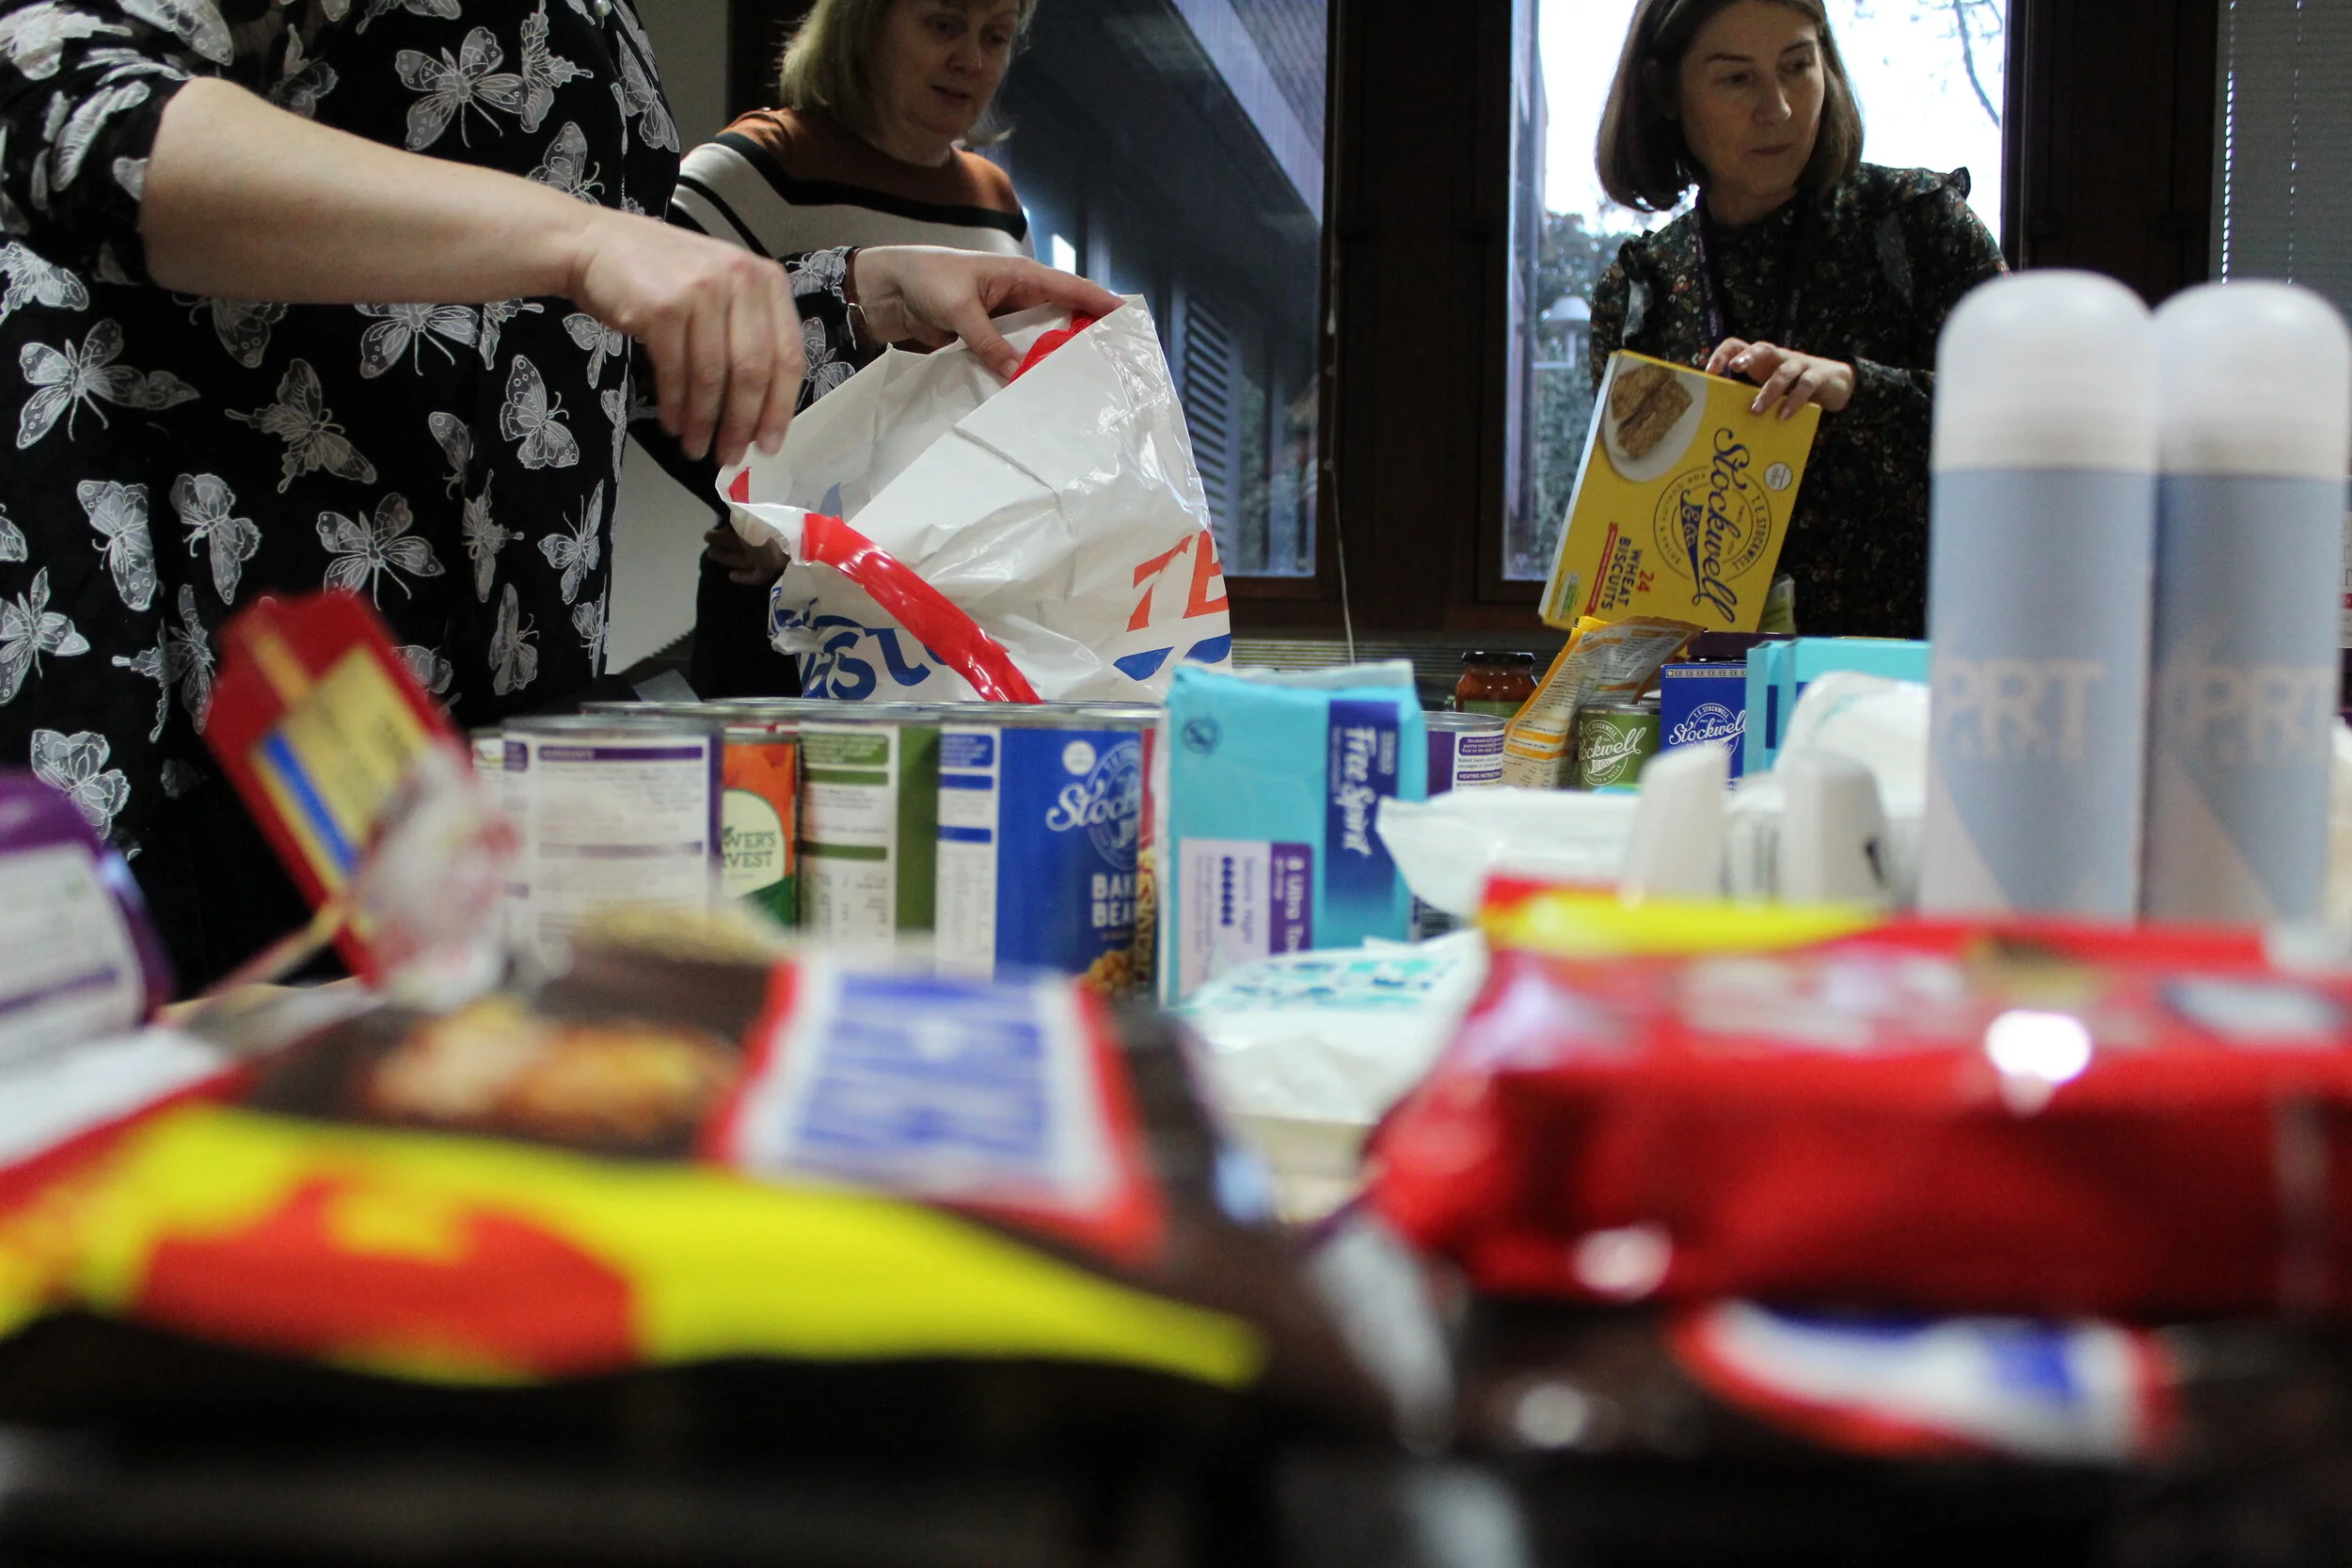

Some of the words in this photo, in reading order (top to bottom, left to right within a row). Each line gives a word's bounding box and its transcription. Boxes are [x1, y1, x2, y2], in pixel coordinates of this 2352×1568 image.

[1702, 428, 1750, 624] Stockwell
[1600, 535, 1633, 611] BISCUITS
[1617, 547, 1644, 608] WHEAT
[1636, 570, 1655, 594] 24
[1702, 705, 1729, 720] STOCKWELL
[1592, 721, 1618, 738] STOCKWELL
[723, 832, 776, 848] WER'S
[725, 850, 772, 868] VEST
